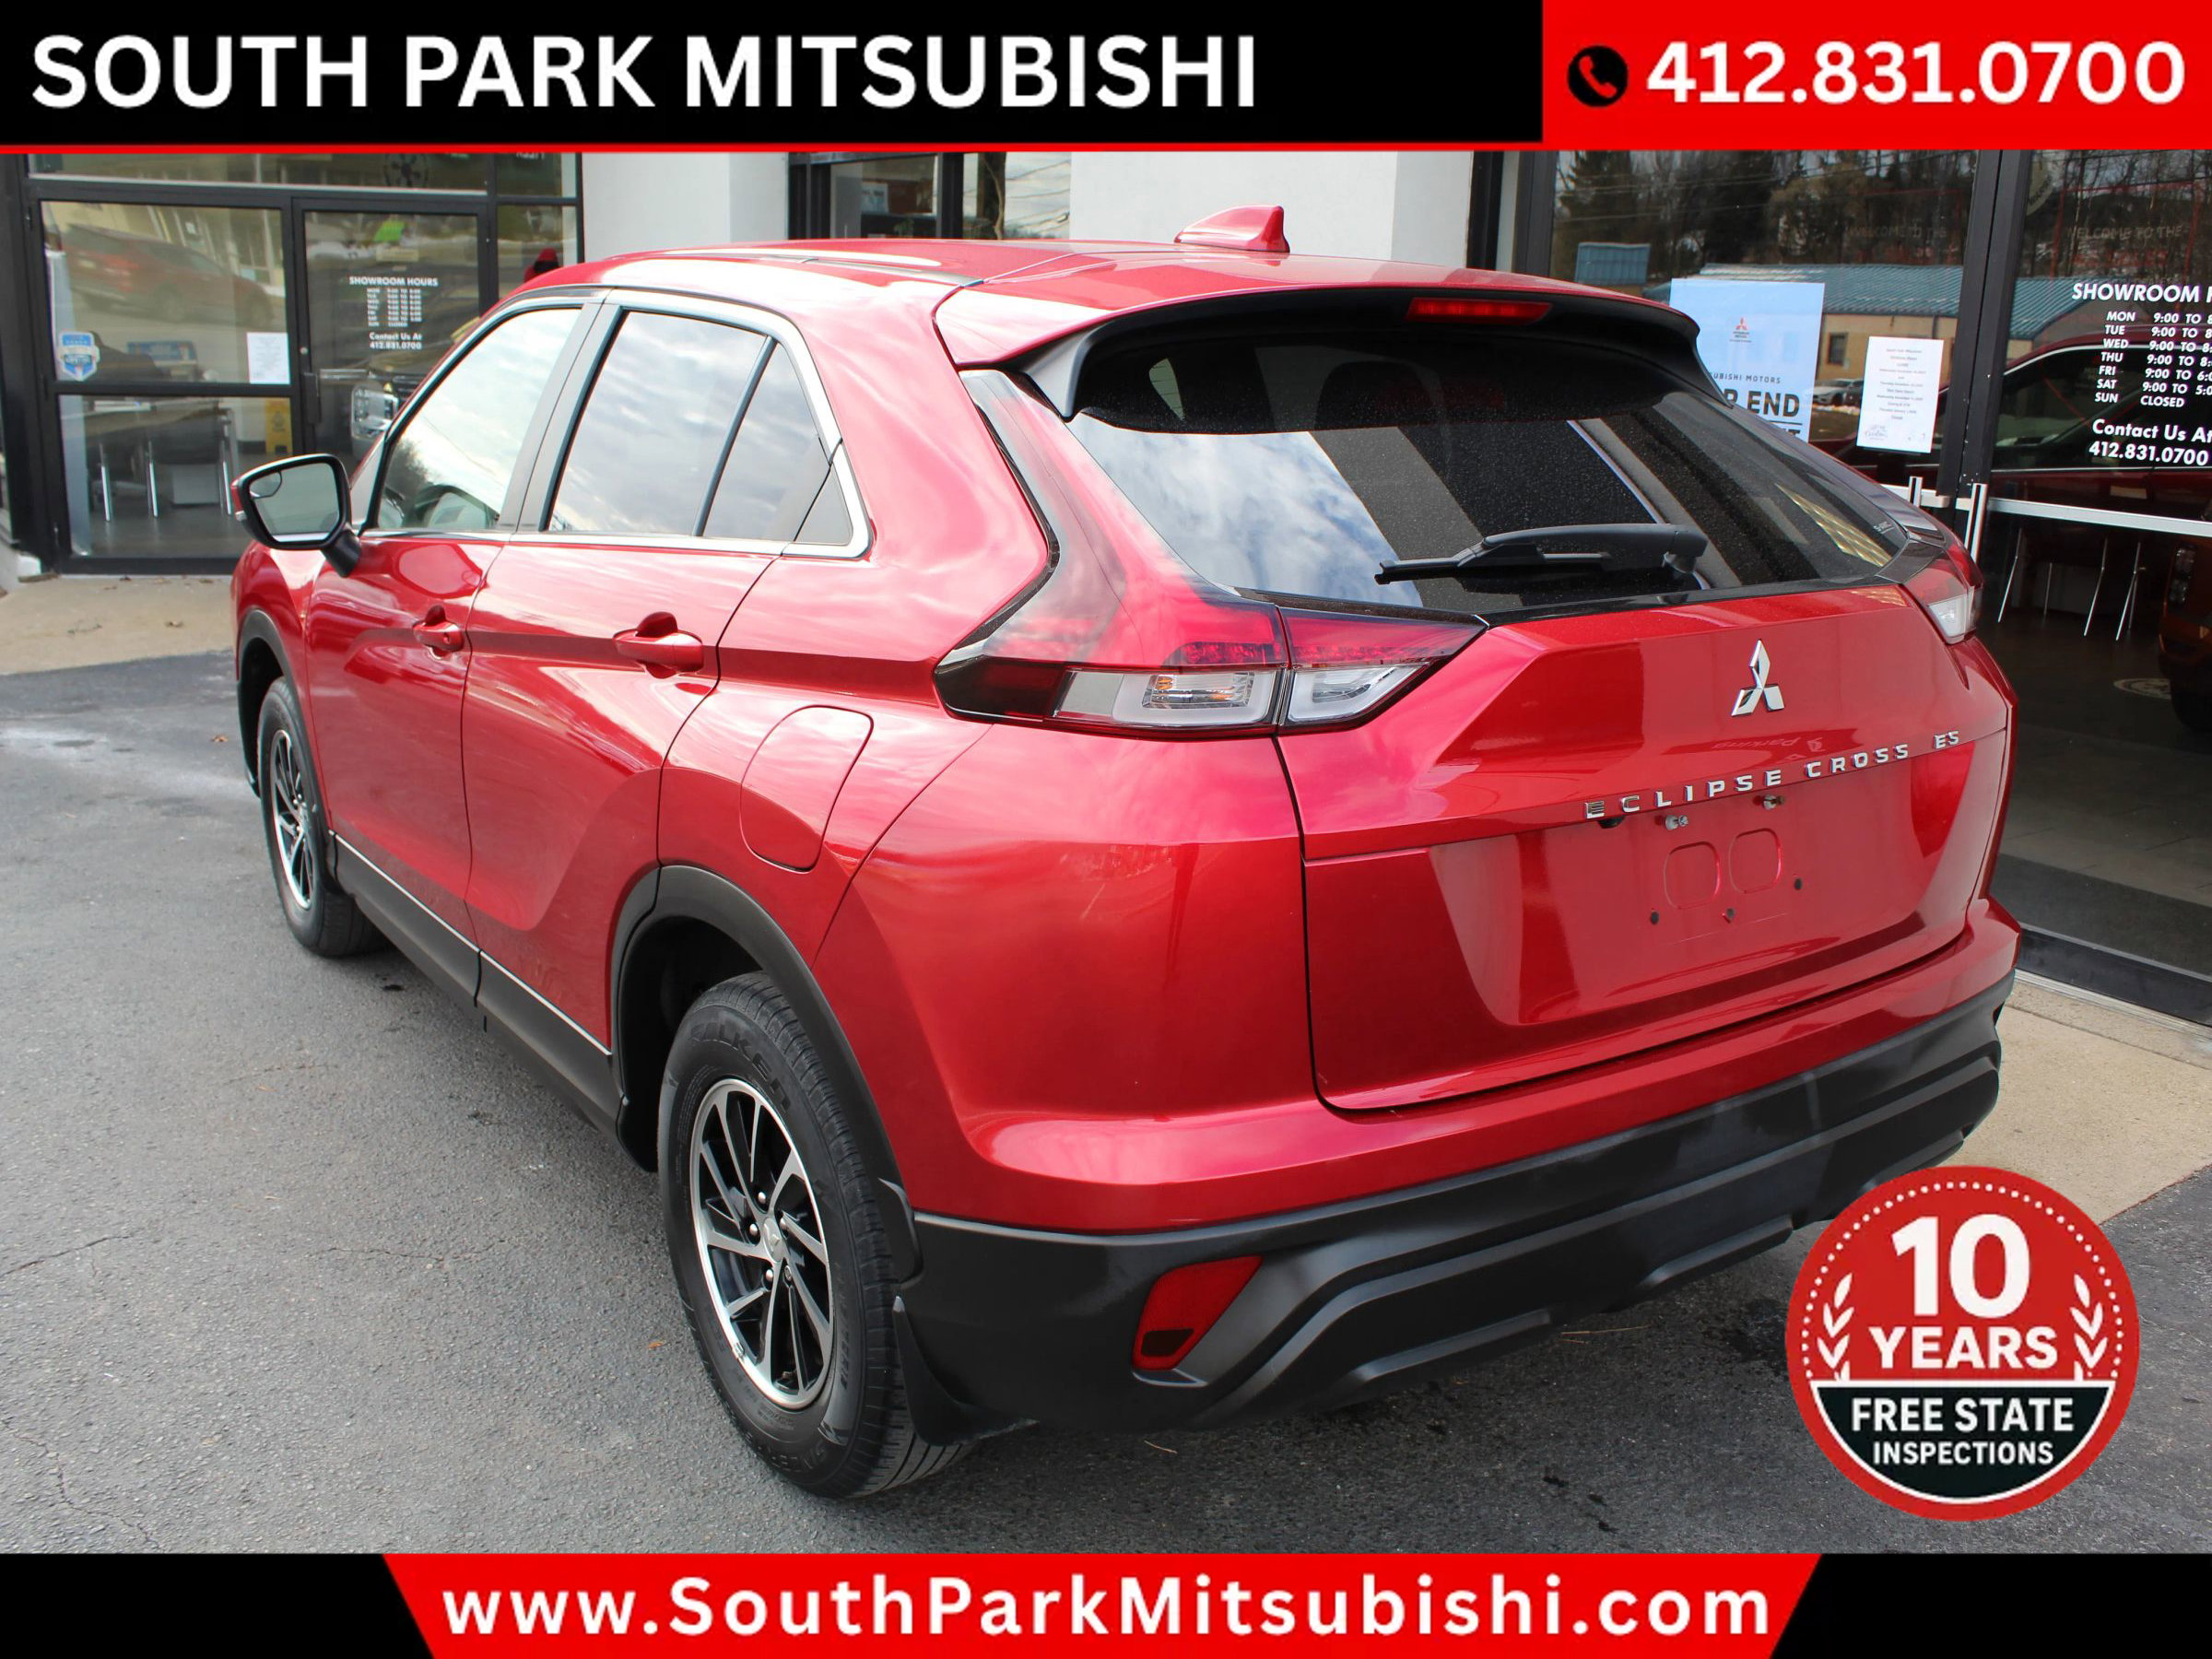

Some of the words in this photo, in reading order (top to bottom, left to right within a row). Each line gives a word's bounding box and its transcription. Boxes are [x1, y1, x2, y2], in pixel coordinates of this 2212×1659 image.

[349, 276, 406, 286] SHOWROOM
[407, 278, 439, 287] HOURS
[2072, 283, 2200, 302] SHOWROOM
[2106, 312, 2136, 322] MON
[2154, 312, 2179, 323] 9:00
[2185, 314, 2201, 324] TO
[2105, 324, 2125, 335] TUE
[2151, 326, 2176, 337] 9:00
[2183, 327, 2198, 338] TO
[2103, 338, 2129, 348] WED
[2149, 340, 2174, 350] 9:00
[2181, 342, 2196, 352] TO
[2101, 352, 2124, 362] THU
[2147, 354, 2172, 365] 9:00
[2179, 356, 2194, 366] TO
[1746, 374, 1782, 384] MOTORS
[2099, 366, 2116, 375] FRI
[2145, 368, 2170, 379] 9:00
[2176, 370, 2192, 380] TO
[2097, 379, 2117, 389] SAT
[2142, 382, 2167, 393] 9:00
[2172, 383, 2188, 394] TO
[1747, 390, 1800, 418] END
[2094, 393, 2119, 403] SUN
[2140, 395, 2185, 407] CLOSED
[2092, 418, 2159, 439] Contact
[2164, 424, 2187, 441] Us
[2191, 427, 2212, 443] At
[2088, 441, 2209, 466] 412.831.0700
[1584, 770, 1783, 819] ECLIPSE
[1806, 744, 1909, 779] CROSS
[1934, 730, 1960, 749] ES
